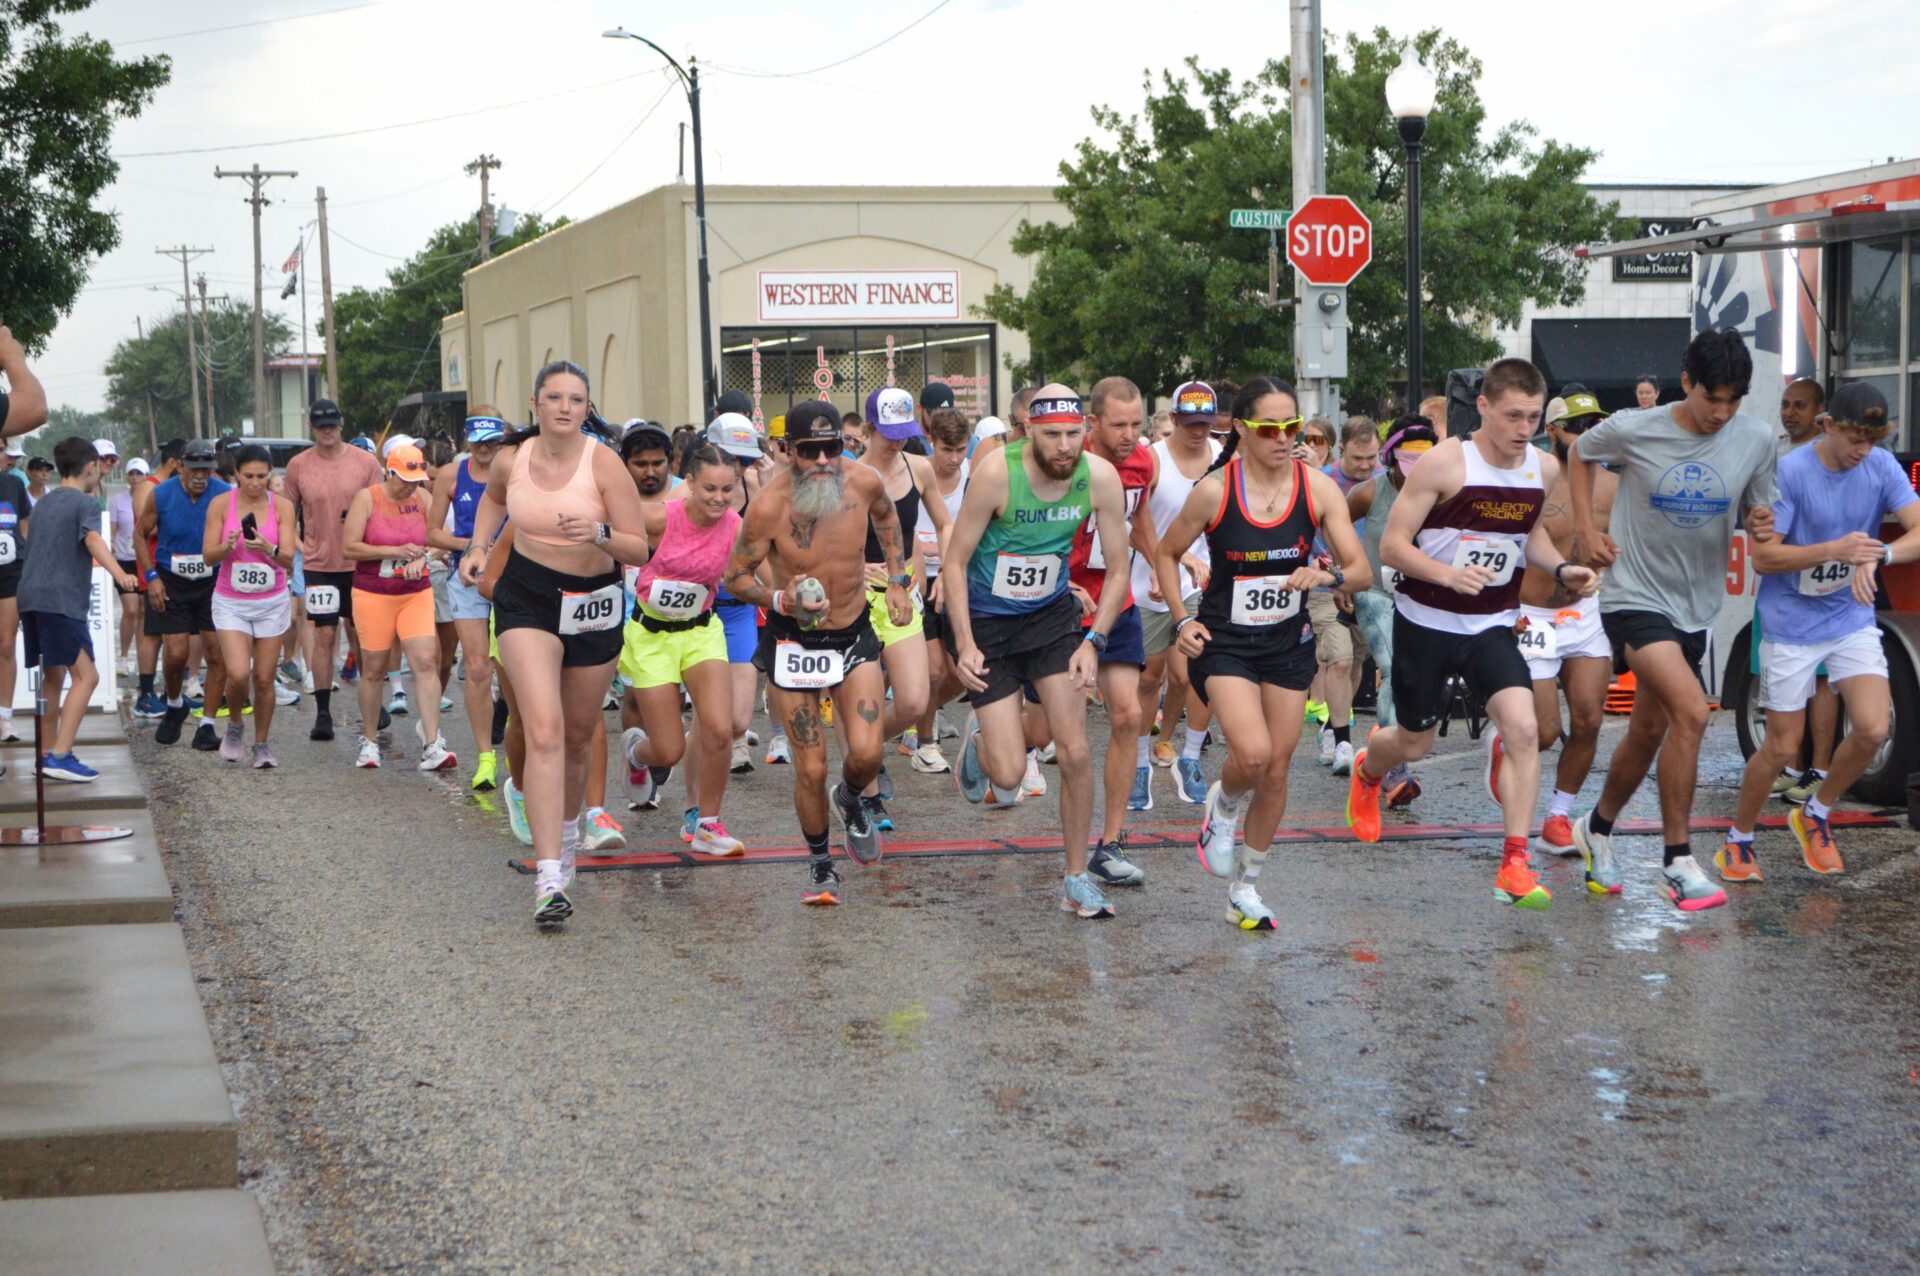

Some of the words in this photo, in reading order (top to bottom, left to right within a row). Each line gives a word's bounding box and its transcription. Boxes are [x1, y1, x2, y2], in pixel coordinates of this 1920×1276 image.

[1235, 212, 1283, 226] AUSTIN
[1292, 223, 1366, 258] STOP
[1623, 263, 1650, 274] Home
[1652, 263, 1679, 274] Decor
[1681, 263, 1689, 274] &
[764, 283, 858, 308] WESTERN
[866, 282, 954, 305] FINANCE
[1014, 505, 1083, 524] RUNLBK
[1472, 501, 1535, 512] KOLLEKTIV
[1480, 509, 1525, 521] RACING
[1226, 550, 1244, 561] RUN
[1245, 550, 1267, 561] NEW
[1267, 548, 1300, 560] MEXICO
[1464, 550, 1508, 573] 379
[178, 561, 206, 575] 568
[238, 569, 268, 586] 383
[1006, 565, 1049, 587] 531
[1810, 562, 1850, 583] 445
[309, 593, 333, 606] 417
[658, 588, 698, 609] 528
[1244, 588, 1292, 611] 368
[571, 597, 614, 622] 409
[786, 653, 831, 674] 500
